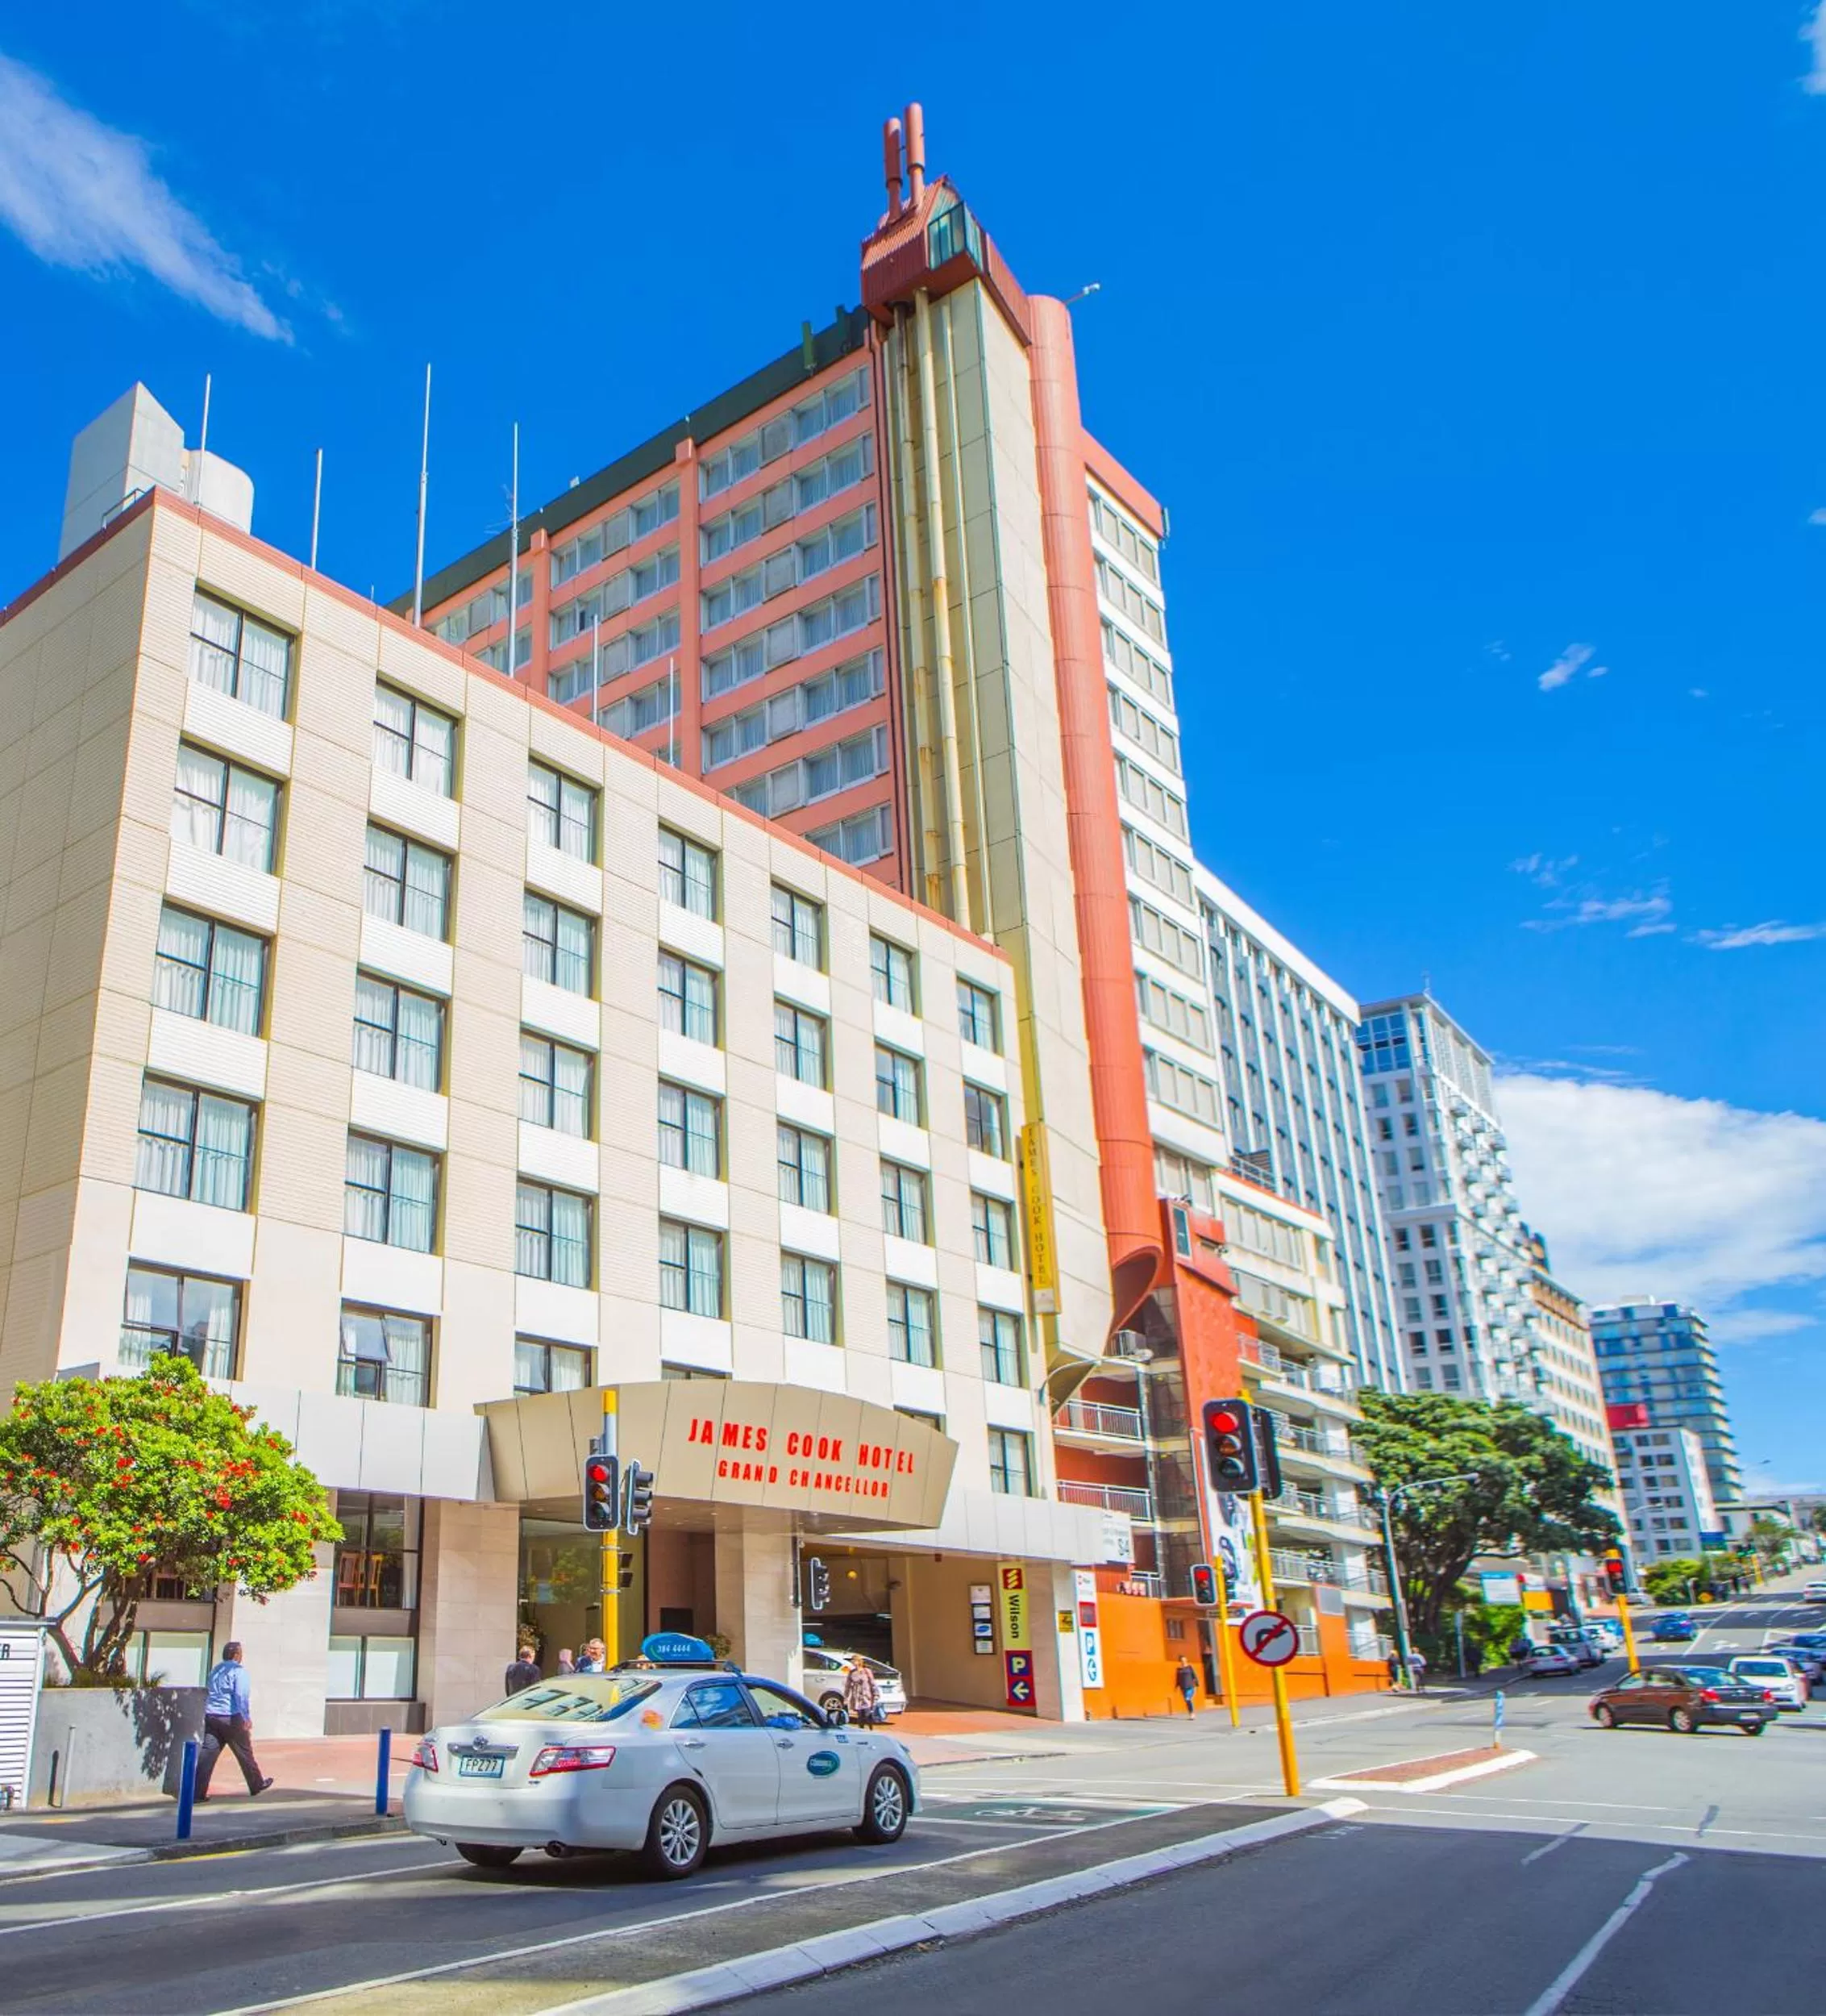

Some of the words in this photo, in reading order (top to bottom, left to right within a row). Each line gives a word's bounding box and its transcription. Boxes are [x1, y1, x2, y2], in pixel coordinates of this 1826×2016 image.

[1034, 1232, 1046, 1285] HOTEL
[688, 1418, 769, 1452] JAMES
[787, 1431, 843, 1462] COOK
[858, 1443, 914, 1474] HOTEL
[718, 1460, 778, 1484] GRAND
[789, 1468, 889, 1498] CHANCELLOR
[1009, 1594, 1021, 1639] Wilson
[0, 1643, 10, 1659] R
[1012, 1656, 1025, 1673] P
